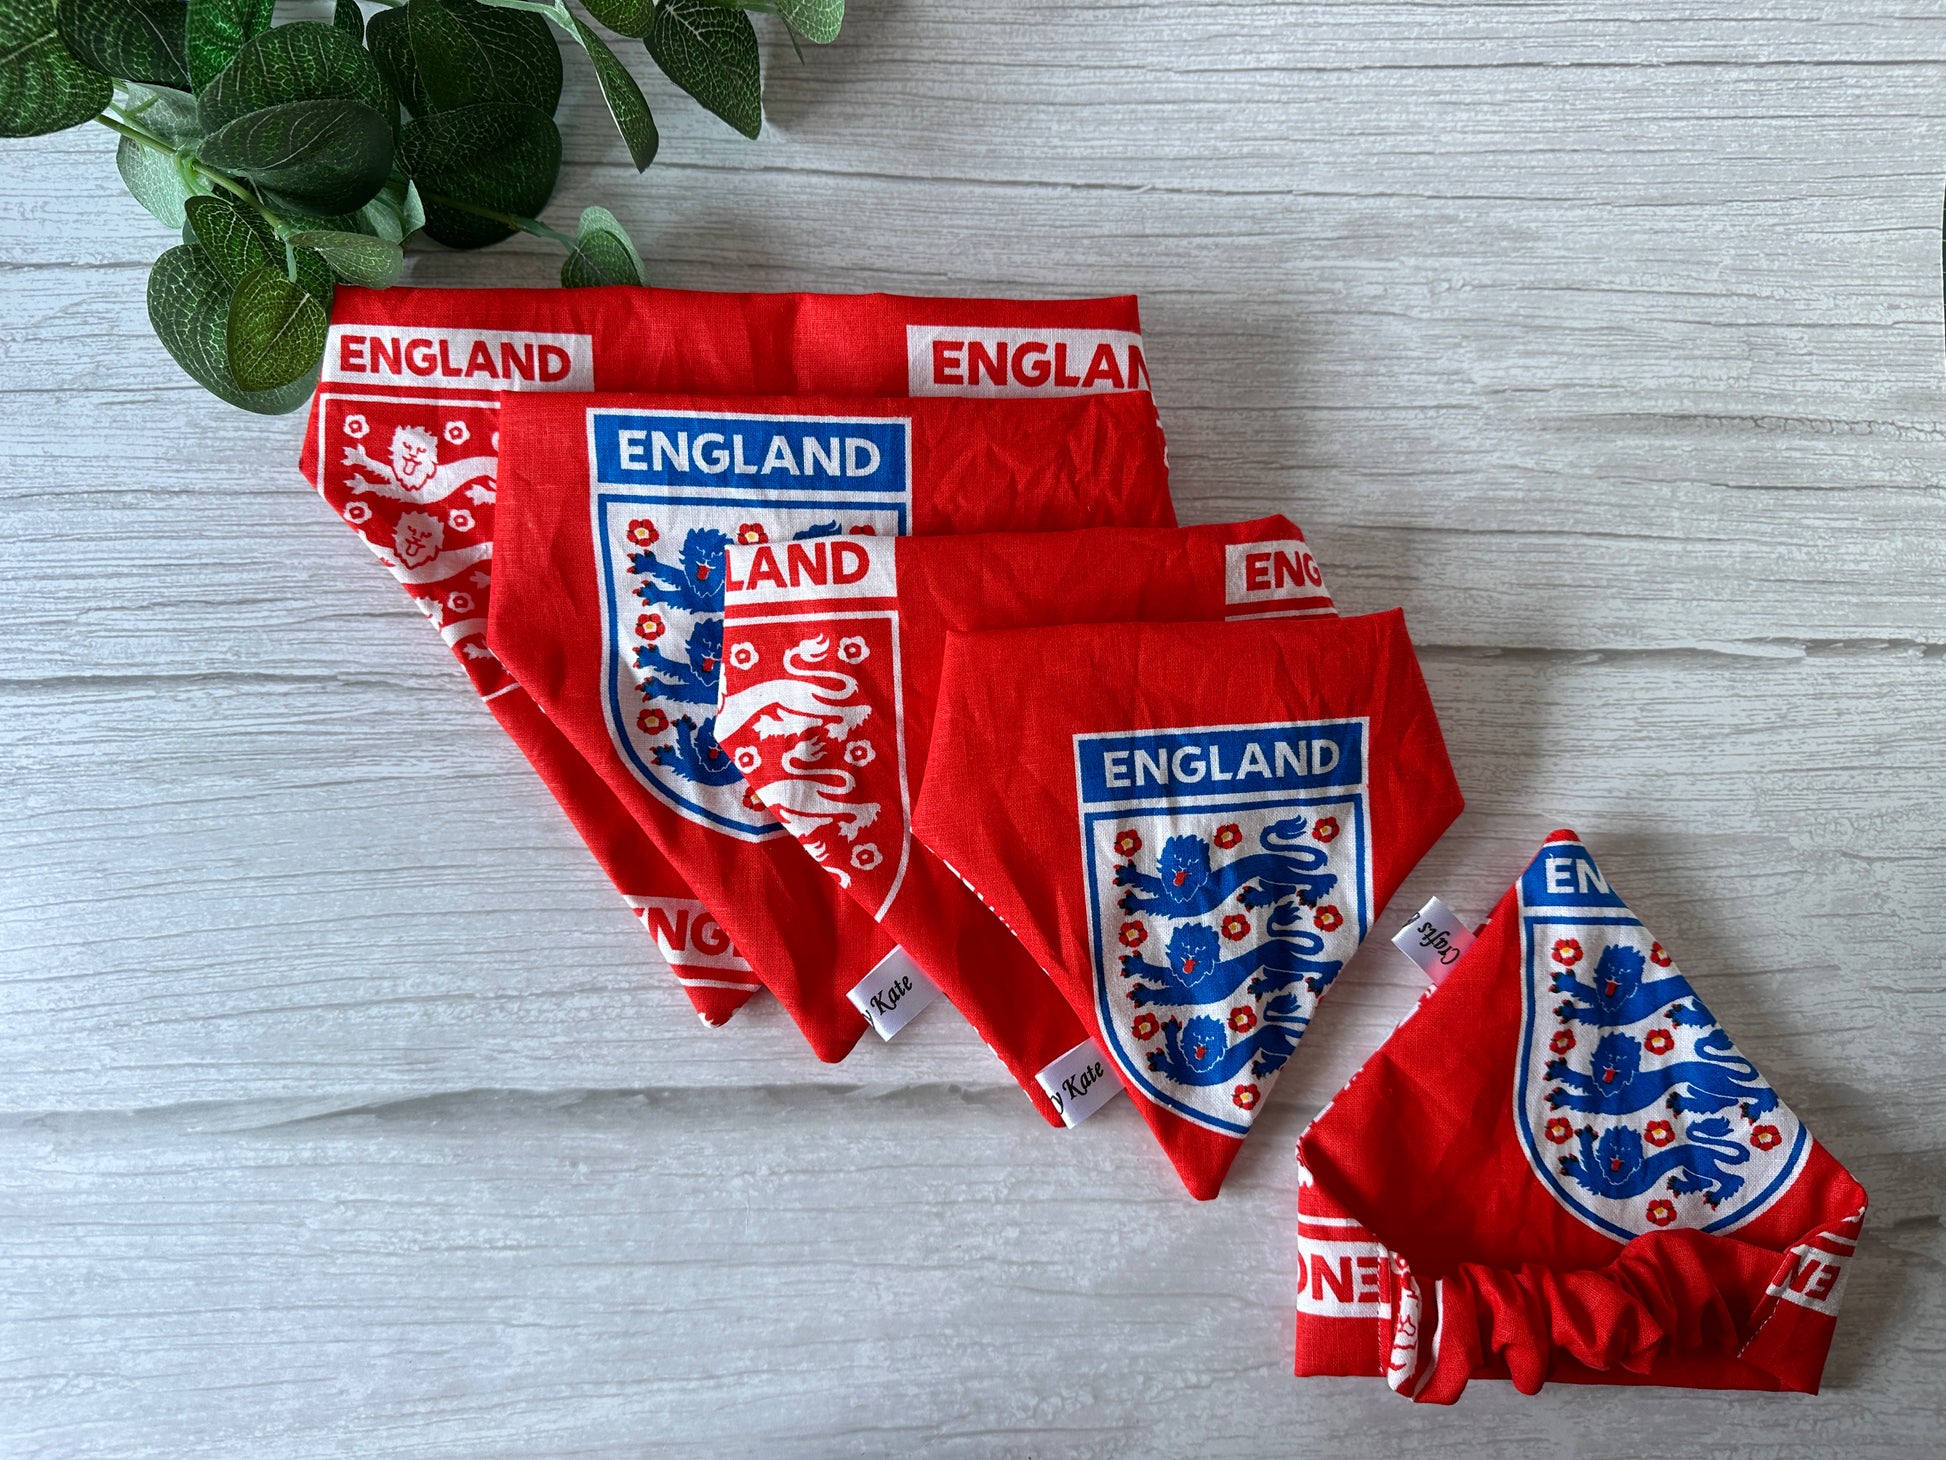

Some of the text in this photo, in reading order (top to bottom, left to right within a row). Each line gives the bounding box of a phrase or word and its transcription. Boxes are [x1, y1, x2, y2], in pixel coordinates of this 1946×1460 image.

[340, 335, 571, 382] ENGLAND
[619, 430, 880, 478] ENGLAND
[1104, 739, 1340, 788] ENGLAND
[1545, 857, 1610, 894] EN
[1417, 921, 1460, 965] Crafts
[870, 975, 912, 1016] Kate
[1062, 1061, 1104, 1100] Kate
